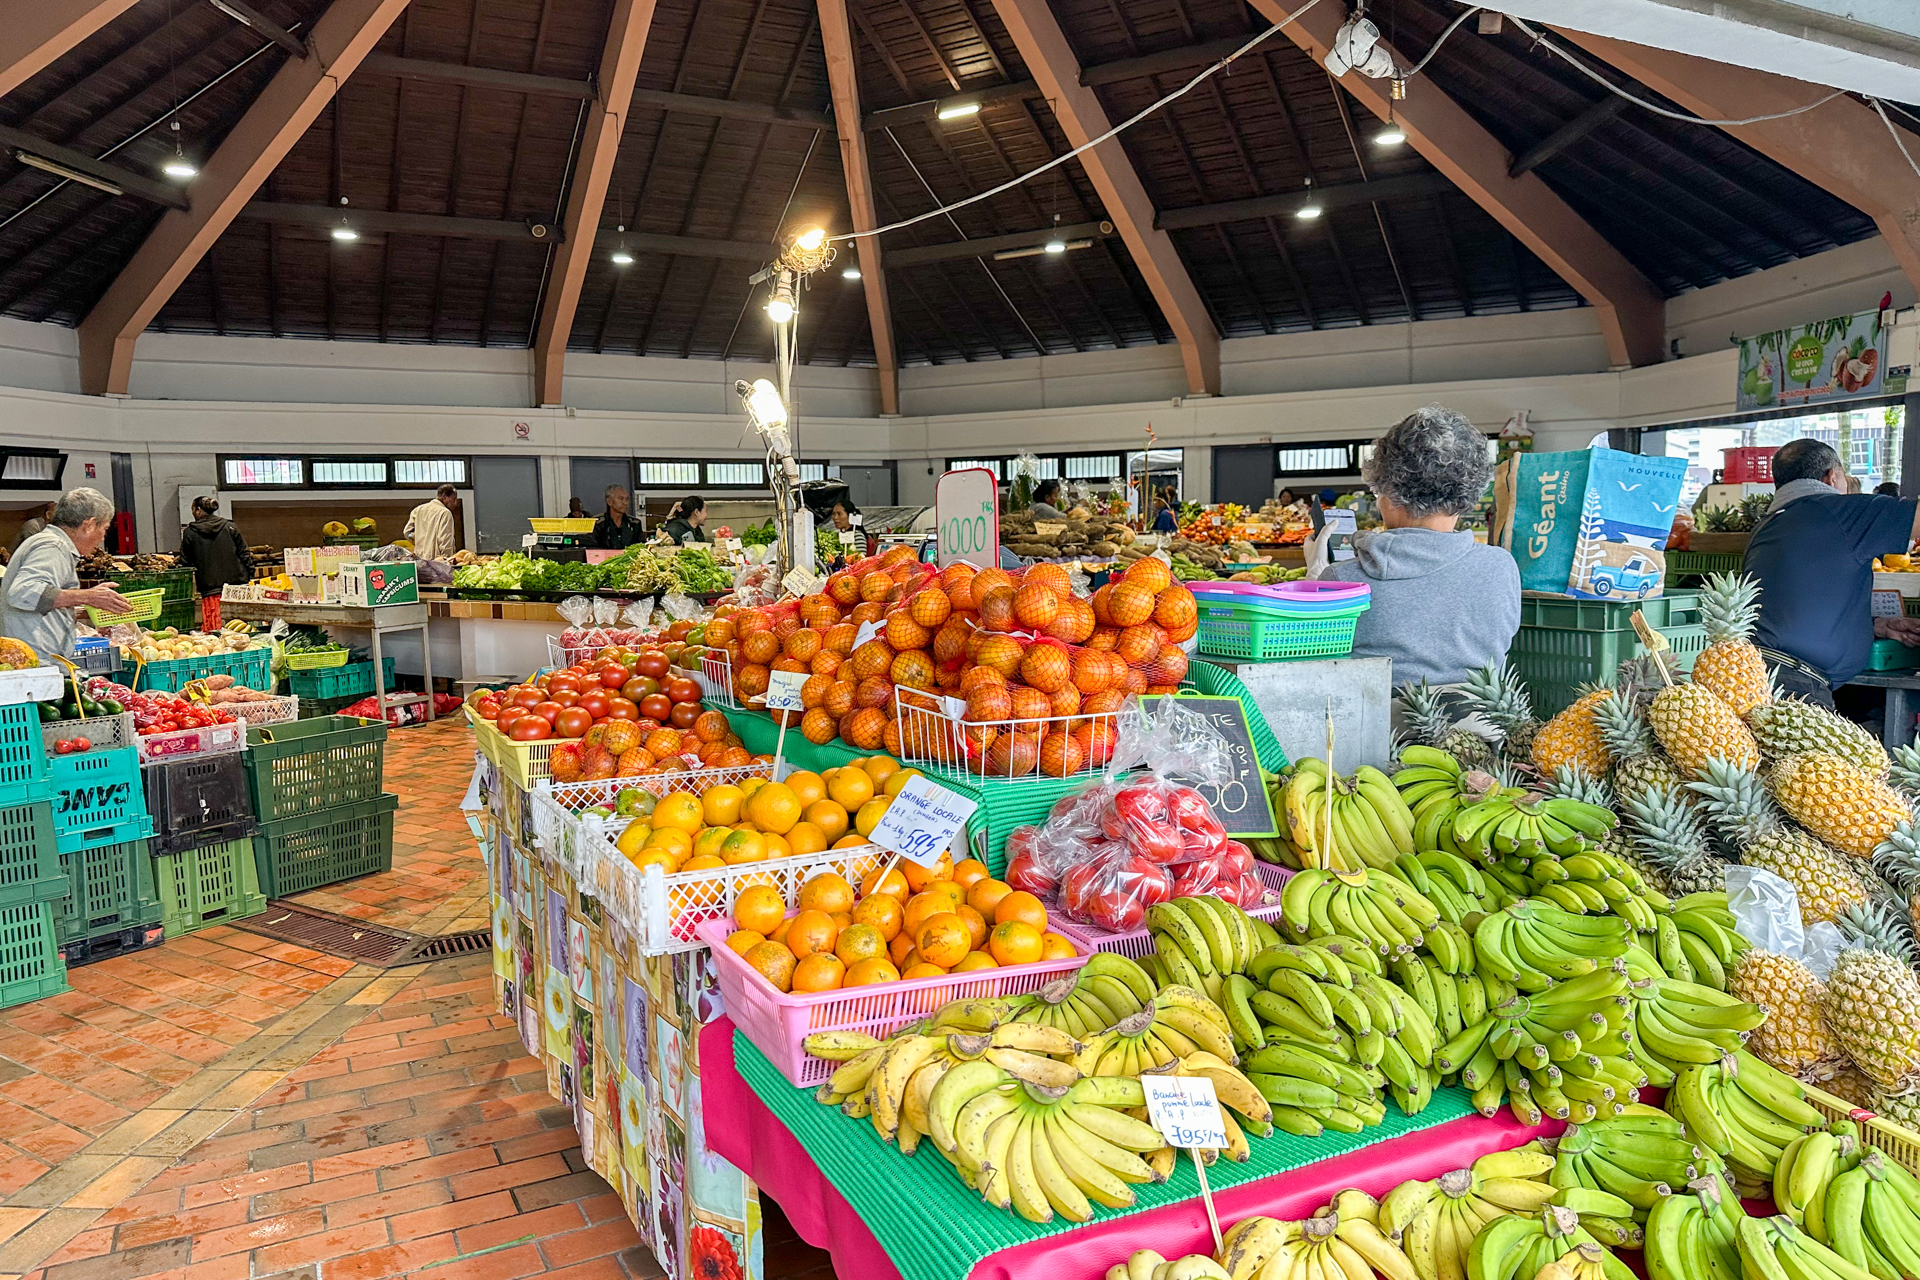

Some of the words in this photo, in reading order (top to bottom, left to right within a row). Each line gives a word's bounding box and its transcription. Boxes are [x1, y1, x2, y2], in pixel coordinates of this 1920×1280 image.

[1557, 470, 1570, 505] Casino
[1628, 466, 1682, 480] NOUVELLE
[1528, 470, 1560, 559] Géant
[375, 575, 399, 603] CRANKY
[381, 576, 415, 604] CAPSICUMS
[899, 790, 932, 810] ORANGE
[932, 806, 965, 825] LOCALE
[898, 829, 943, 858] 595
